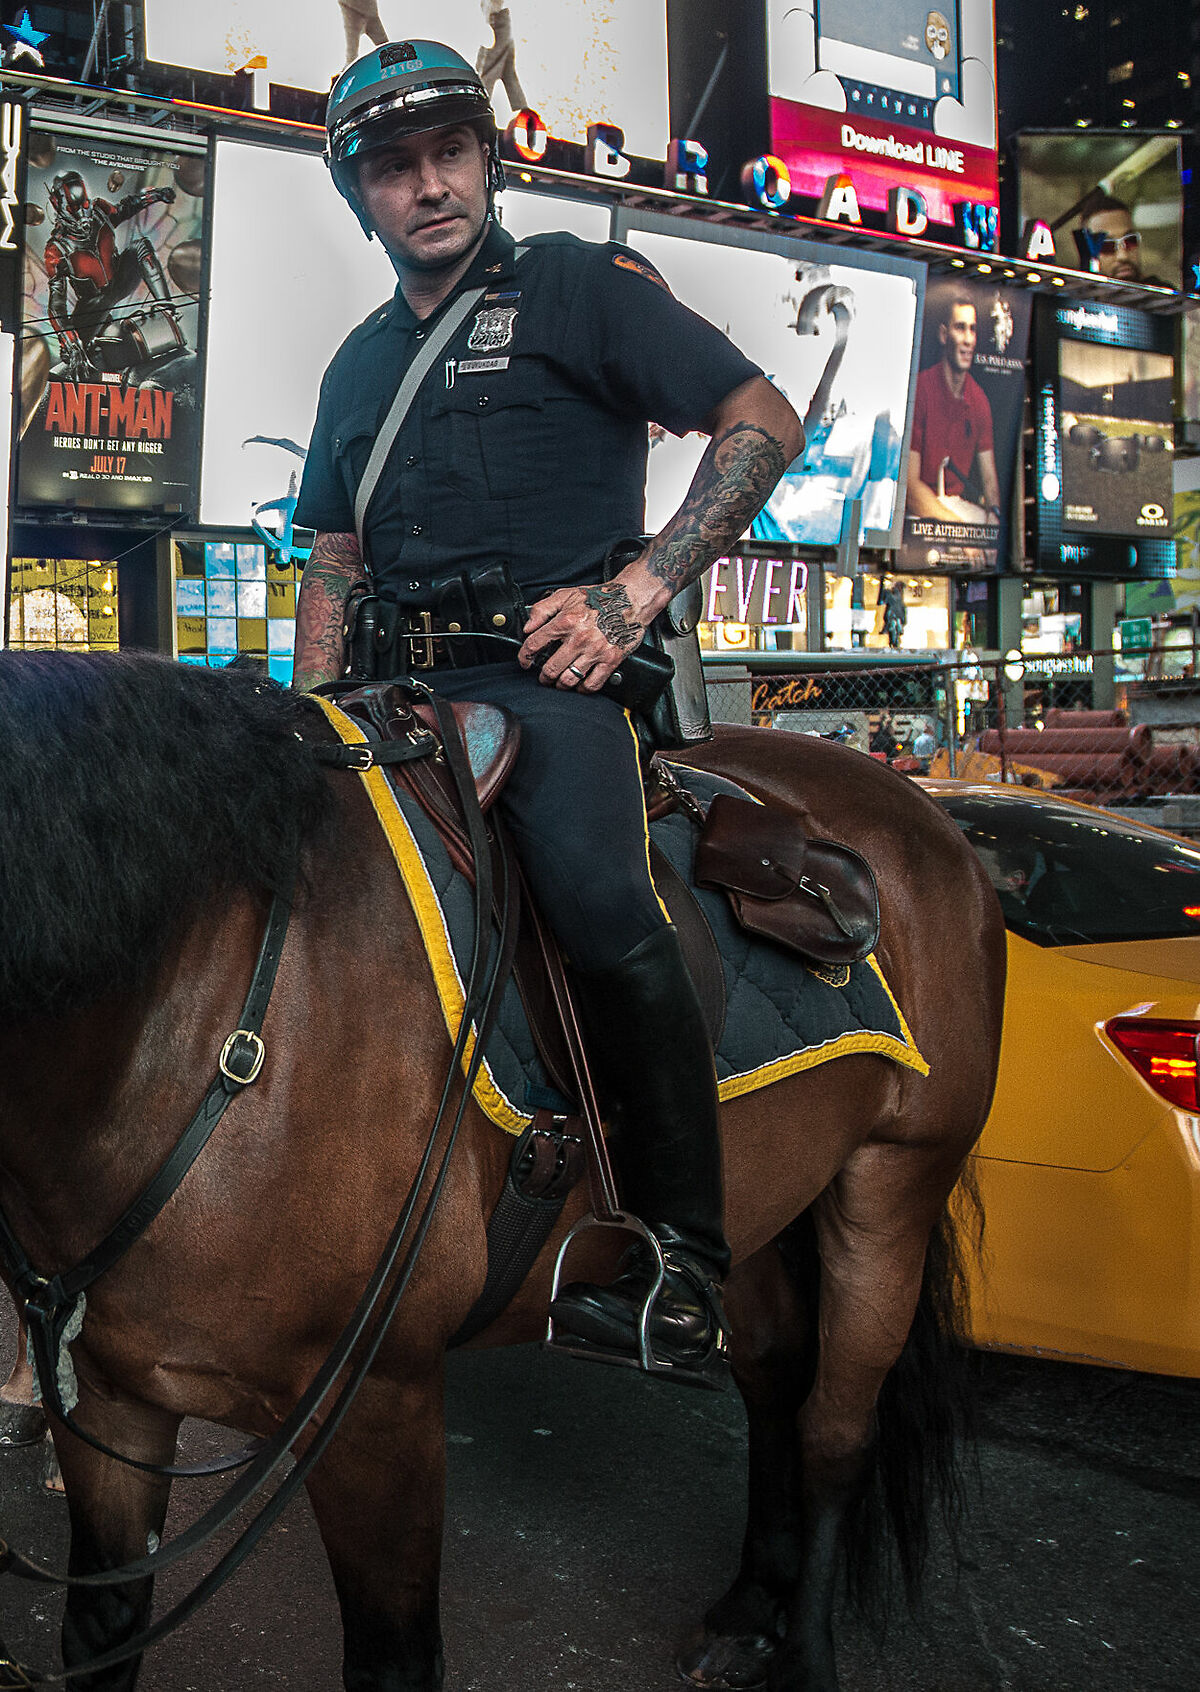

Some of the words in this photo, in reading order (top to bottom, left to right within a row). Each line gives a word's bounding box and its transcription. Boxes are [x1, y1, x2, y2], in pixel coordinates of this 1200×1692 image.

[56, 146, 77, 154] FROM
[77, 149, 91, 157] THE
[91, 151, 116, 160] STUDIO
[117, 155, 134, 163] THAT
[841, 124, 924, 164] Download
[926, 144, 965, 174] LINE
[588, 122, 1107, 273] BROADWAY
[45, 382, 175, 440] ANT-MAN
[53, 436, 81, 449] HEROES
[83, 438, 104, 450] DON'T
[107, 440, 119, 451] GET
[122, 441, 136, 452] ANY
[90, 455, 114, 473] JULY
[116, 456, 127, 474] 17
[912, 523, 934, 535] LIVE
[935, 524, 999, 540] AUTHENTICALLY
[707, 557, 809, 623] EVER
[752, 678, 824, 711] Catch
